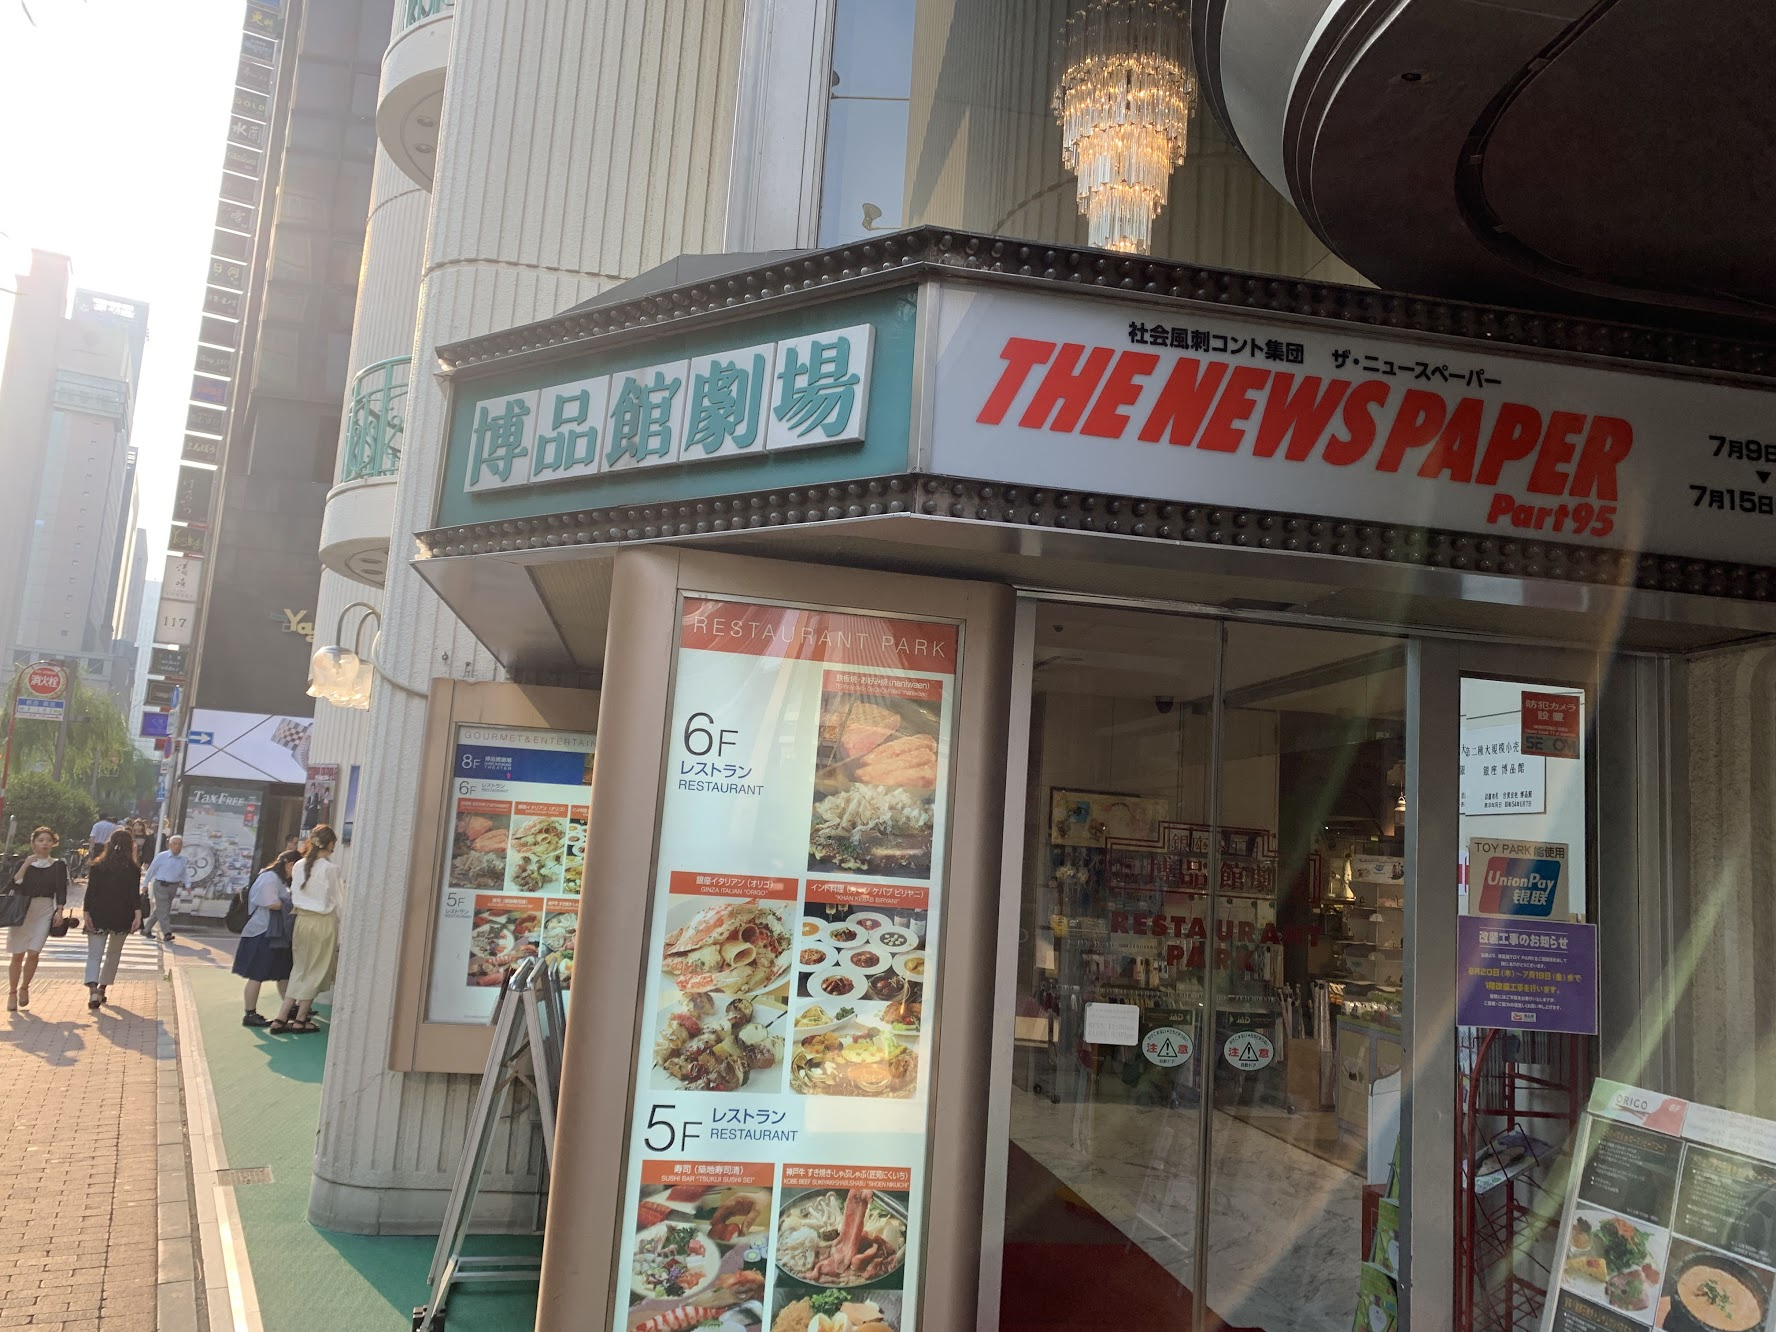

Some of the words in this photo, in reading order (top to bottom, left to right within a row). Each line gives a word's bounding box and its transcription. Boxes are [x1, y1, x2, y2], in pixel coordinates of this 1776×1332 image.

[1128, 321, 1305, 365] 社会風刺コント集団
[1331, 349, 1503, 388] ザ・ニュースペーパー
[977, 337, 1152, 440] THE
[469, 335, 861, 486] 博品館劇場
[1708, 434, 1776, 463] 7月9日
[1689, 484, 1774, 515] 7月15日
[1487, 492, 1616, 538] Part95
[163, 616, 187, 628] 117
[693, 616, 869, 651] RESTAURANT
[881, 637, 946, 658] PARK
[30, 674, 60, 688] 消火栓
[1524, 698, 1576, 713] 防犯カメラ
[1537, 711, 1565, 722] 設置
[683, 712, 739, 757] 6F
[1526, 735, 1577, 754] SEOM
[461, 754, 481, 769] 8F
[679, 760, 753, 779] レストラン
[459, 780, 478, 795] 6F
[678, 779, 764, 796] RESTAURANT
[1474, 842, 1499, 853] TOY
[1502, 844, 1532, 856] PARK
[1487, 870, 1555, 895] UnionPay
[446, 892, 466, 907] 5F
[1512, 889, 1548, 905] 银联
[1110, 911, 1324, 947] RESTAURAT
[1166, 943, 1255, 972] PARK
[1616, 1094, 1648, 1110] ORIGO
[711, 1106, 786, 1125] レストラン
[643, 1104, 703, 1153] 5F
[709, 1127, 798, 1142] RESTAURANT
[786, 1167, 805, 1177] 神戸牛
